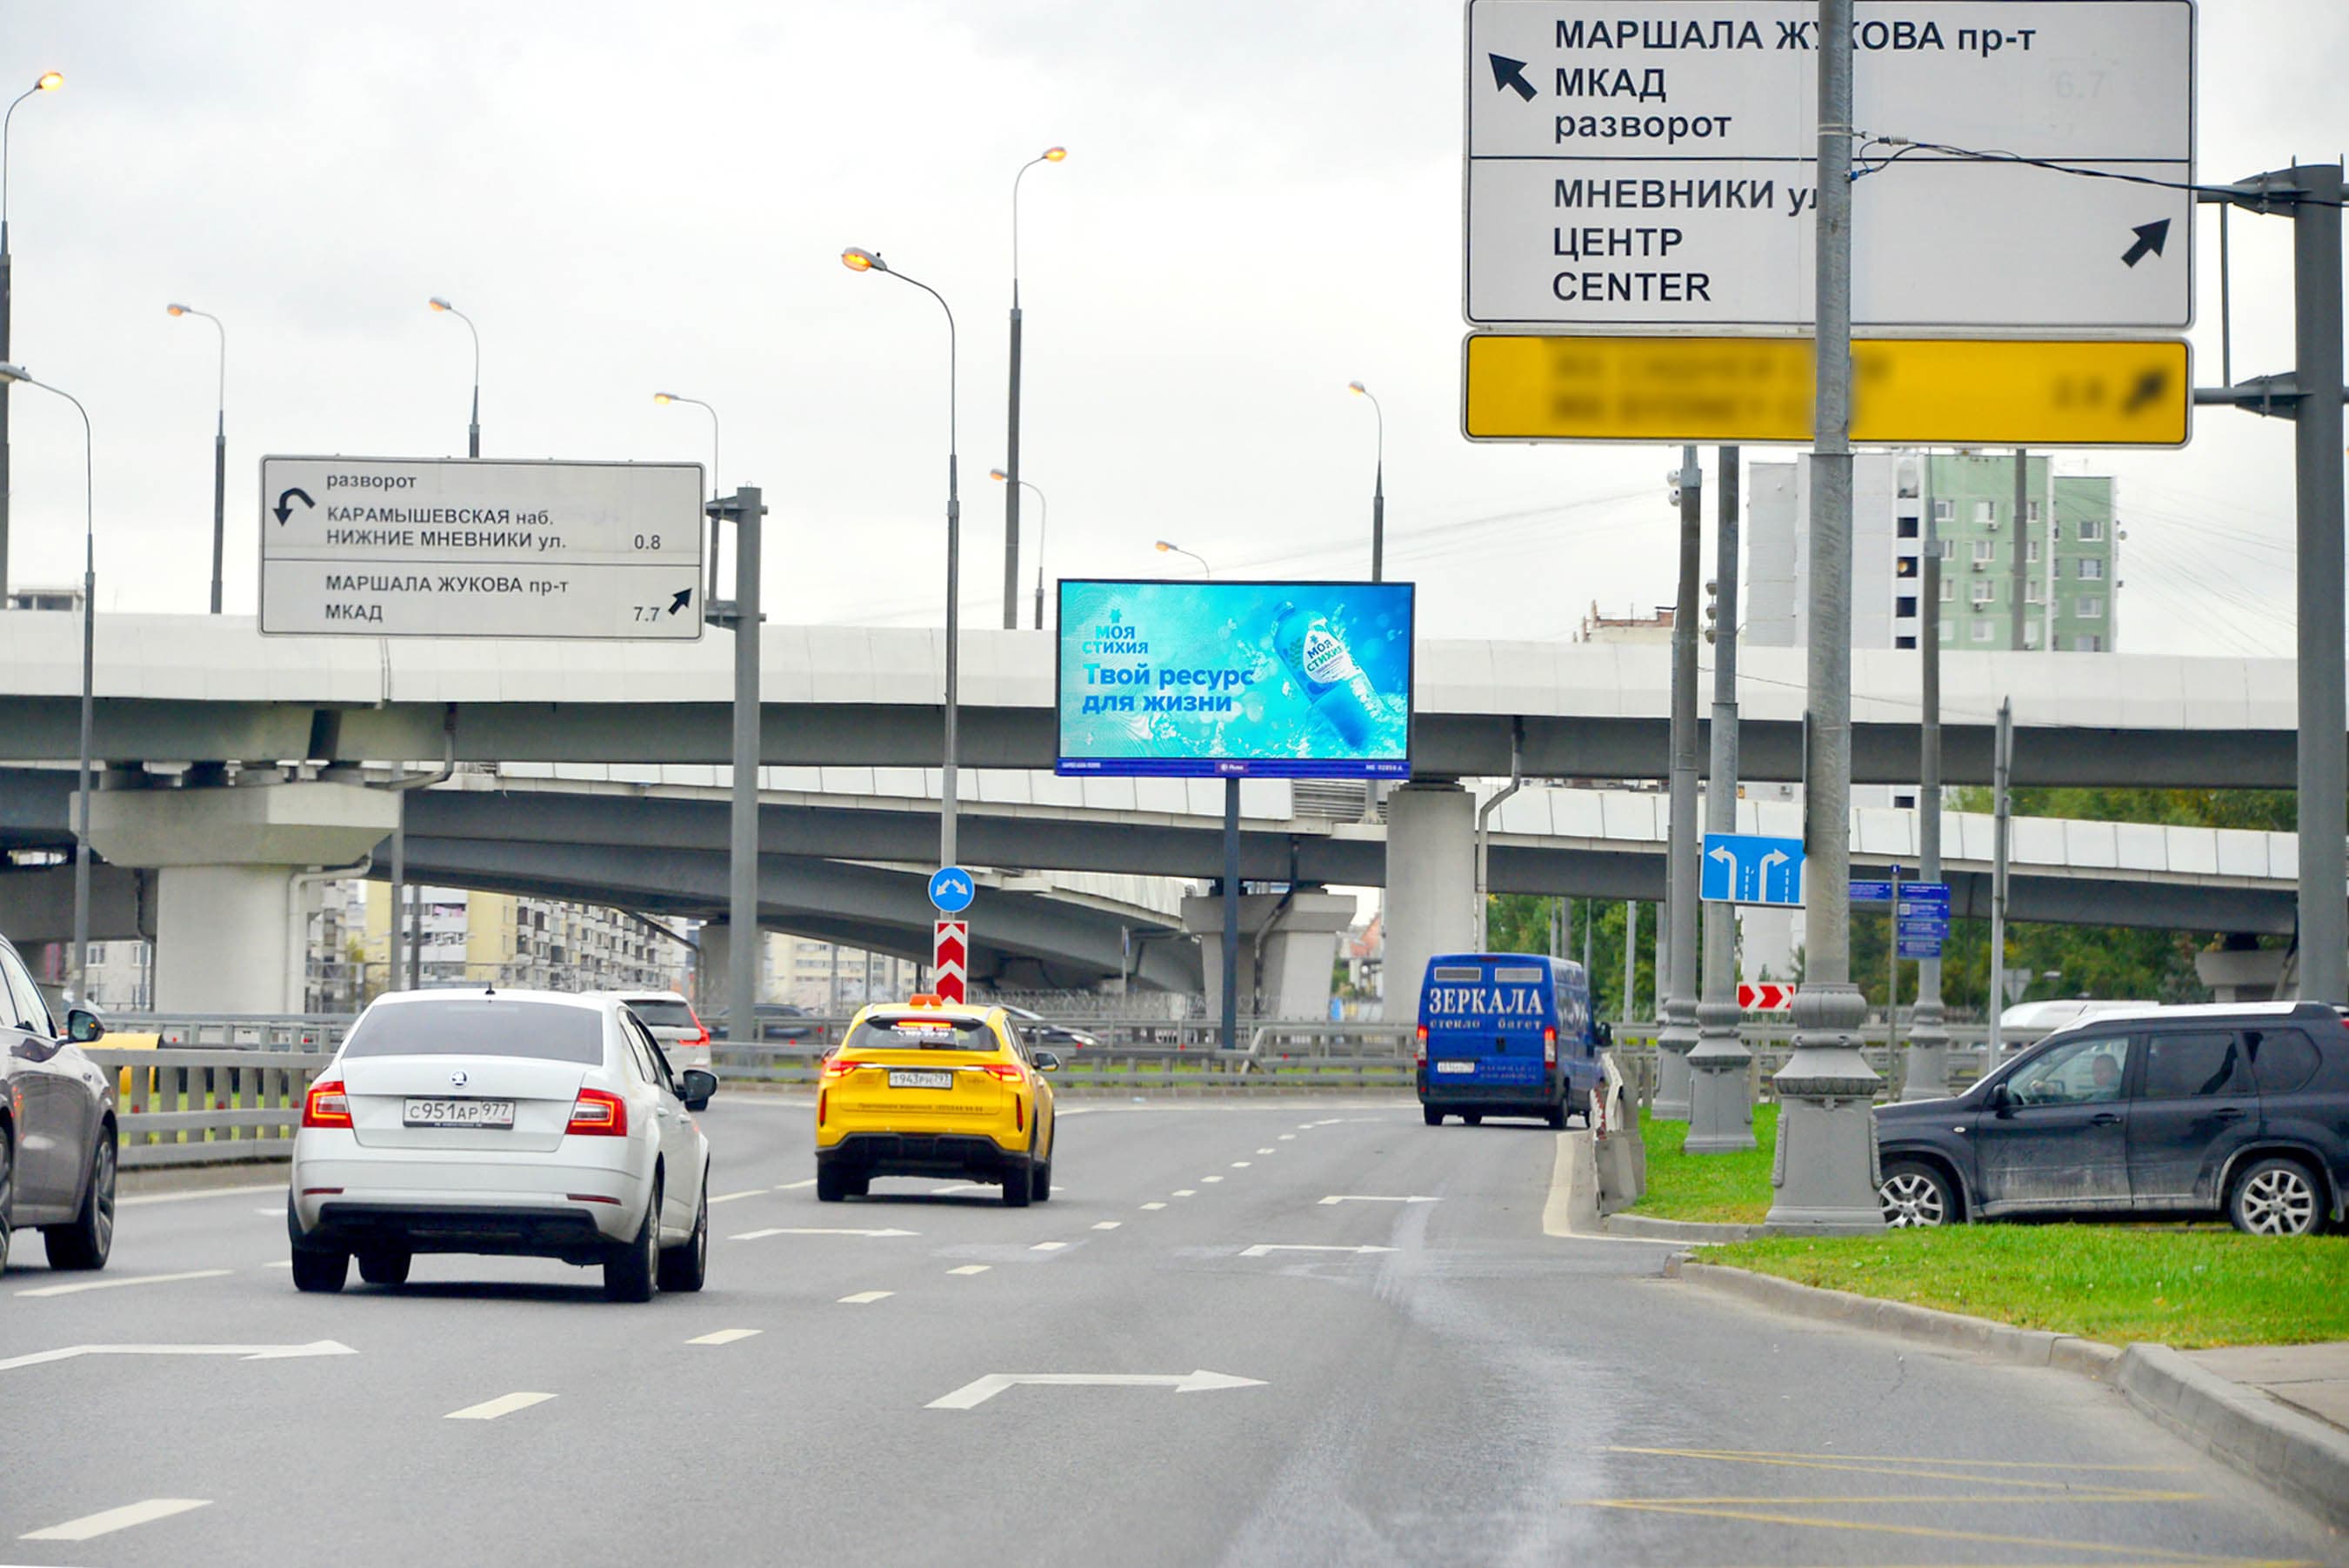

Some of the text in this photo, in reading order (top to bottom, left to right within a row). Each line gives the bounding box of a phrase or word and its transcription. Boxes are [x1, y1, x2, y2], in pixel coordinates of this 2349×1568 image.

[1556, 20, 2036, 58] МАРШАЛА ЖОВА пр-т
[1556, 68, 1666, 103] МКАД
[1555, 116, 1732, 145] разворот
[1555, 179, 1773, 209] МНЕВНИКИ
[1554, 227, 1683, 262] ЦЕНТР
[1552, 271, 1711, 302] CENTER
[327, 475, 417, 491] разворот
[328, 507, 554, 525] КАРАМЫШЕВСКАЯ наб.
[327, 530, 566, 552] НИЖНИЕ МНЕВНИКИ ул.
[634, 534, 661, 550] 0.8
[326, 575, 568, 597] МАРШАЛА ЖУКОВА пр-т
[326, 604, 383, 622] МКАД
[634, 606, 660, 622] 7.7
[1096, 625, 1135, 639] МОЯ
[1082, 642, 1148, 654] СТИХИЯ
[1307, 639, 1333, 659] МОЯ
[1083, 663, 1255, 691] Твой ресурс
[1082, 696, 1231, 715] для жизни
[1429, 987, 1545, 1015] ЗЕРКАЛА
[1430, 1018, 1480, 1030] стекло
[482, 1103, 509, 1116] 977
